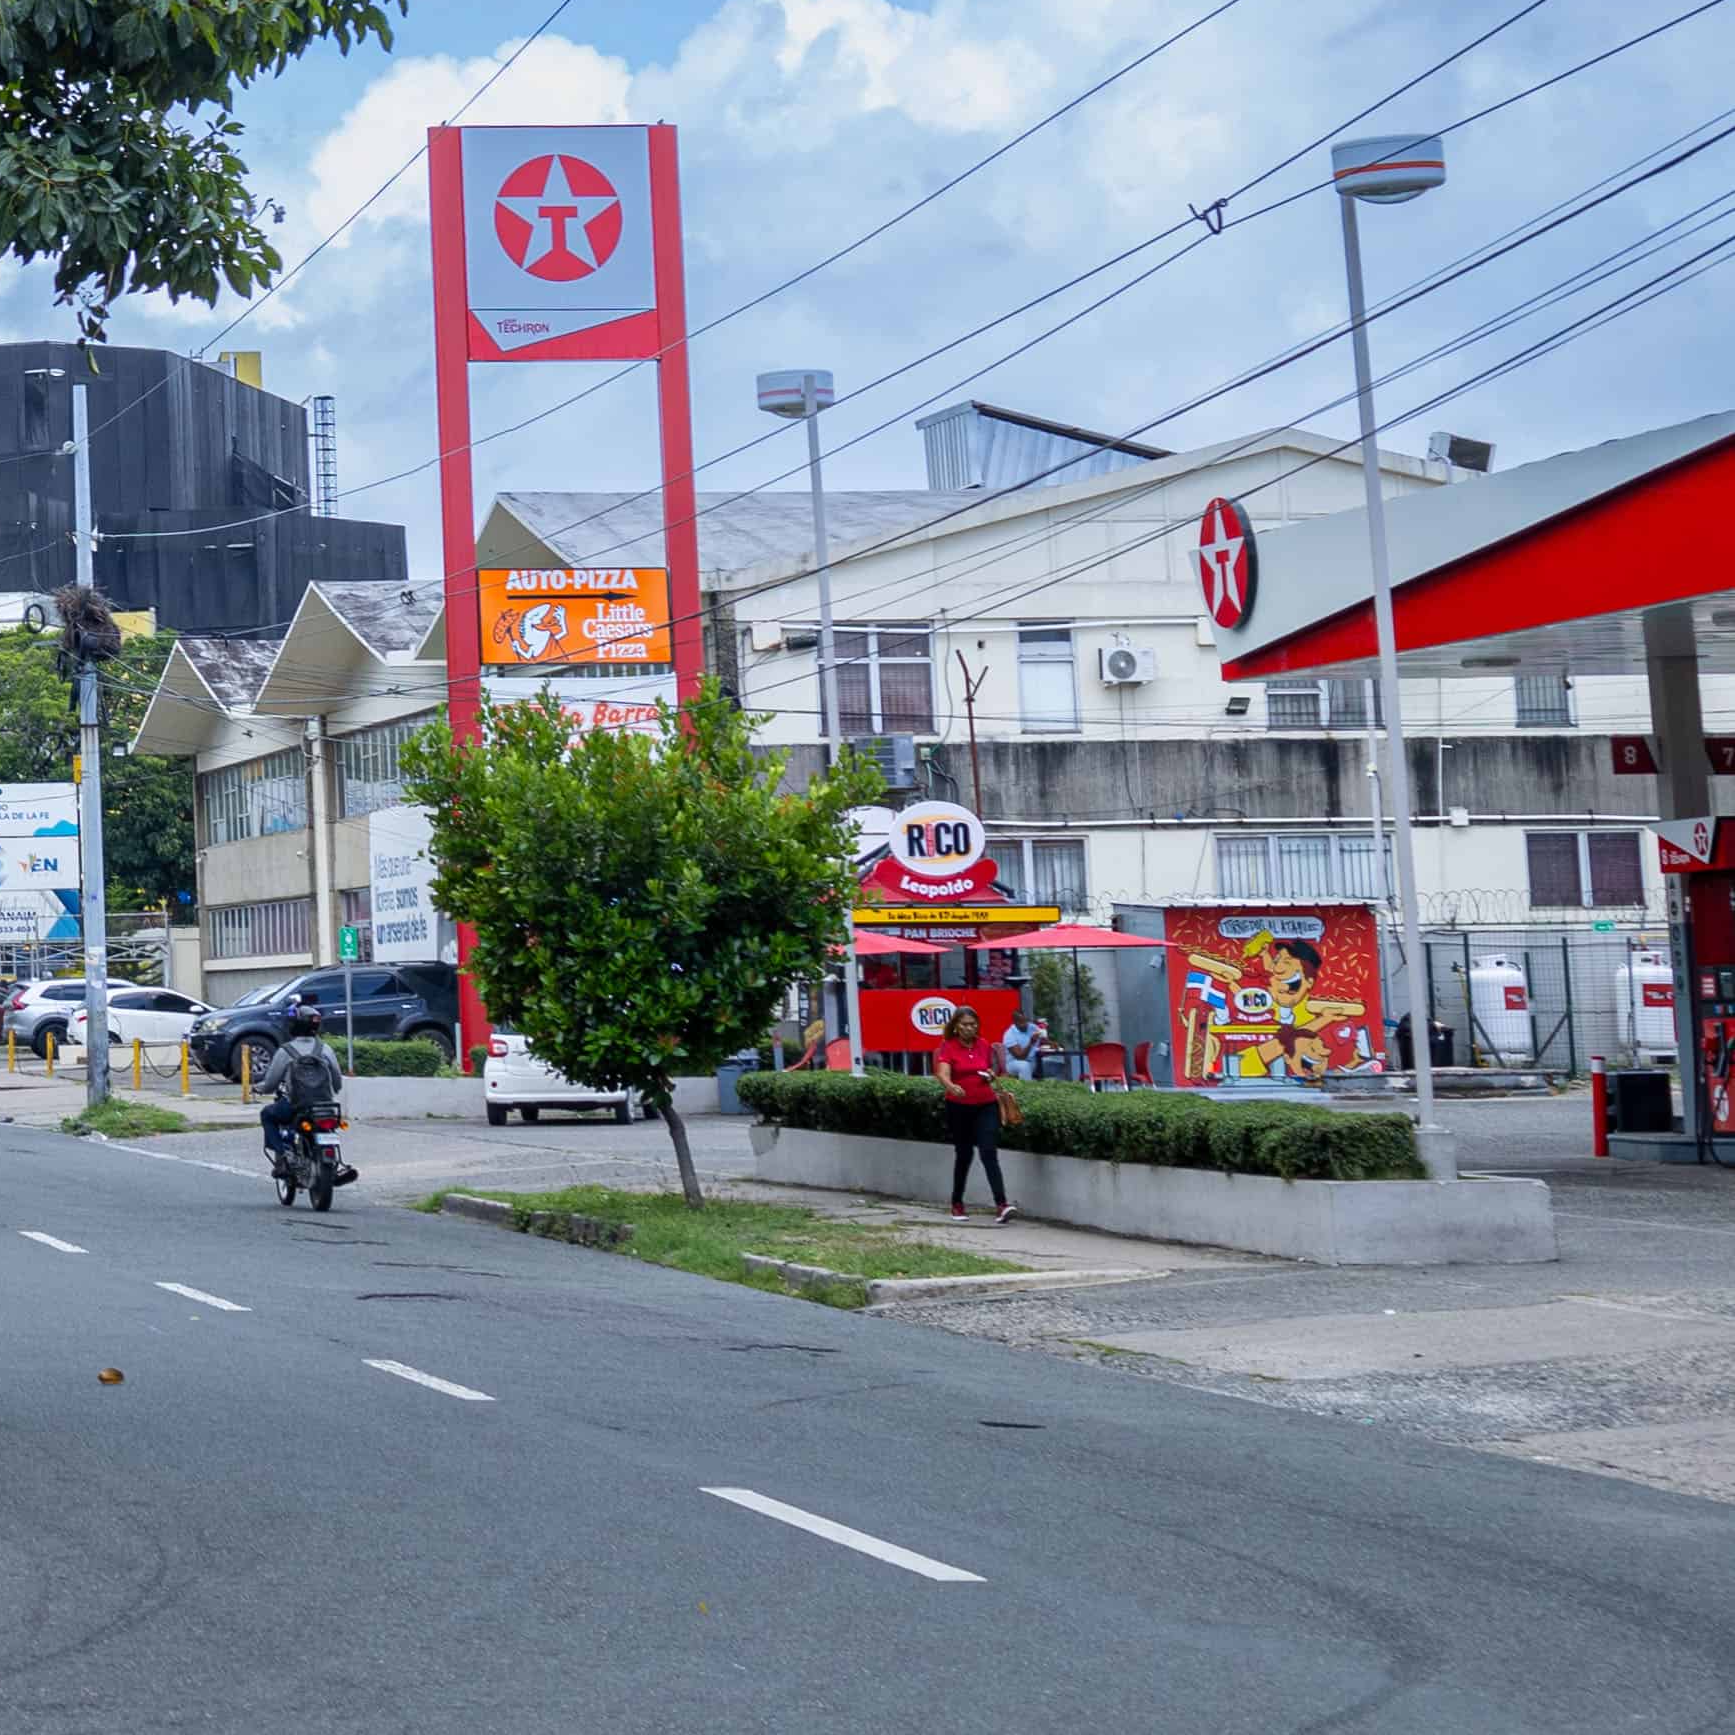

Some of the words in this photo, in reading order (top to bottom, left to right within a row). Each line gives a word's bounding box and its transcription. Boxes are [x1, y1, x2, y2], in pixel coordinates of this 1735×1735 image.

[505, 570, 638, 590] AUTO-PIZZA
[596, 603, 645, 622] Little
[582, 618, 655, 639] Caesars
[597, 639, 648, 659] Pizza
[1623, 746, 1638, 764] 8
[12, 812, 27, 820] DE
[40, 811, 49, 819] FE
[906, 822, 971, 857] RICO
[900, 875, 975, 899] Leopoldo
[904, 928, 927, 938] PAN
[929, 927, 977, 938] BRIOCHE
[919, 1008, 952, 1025] RICO
